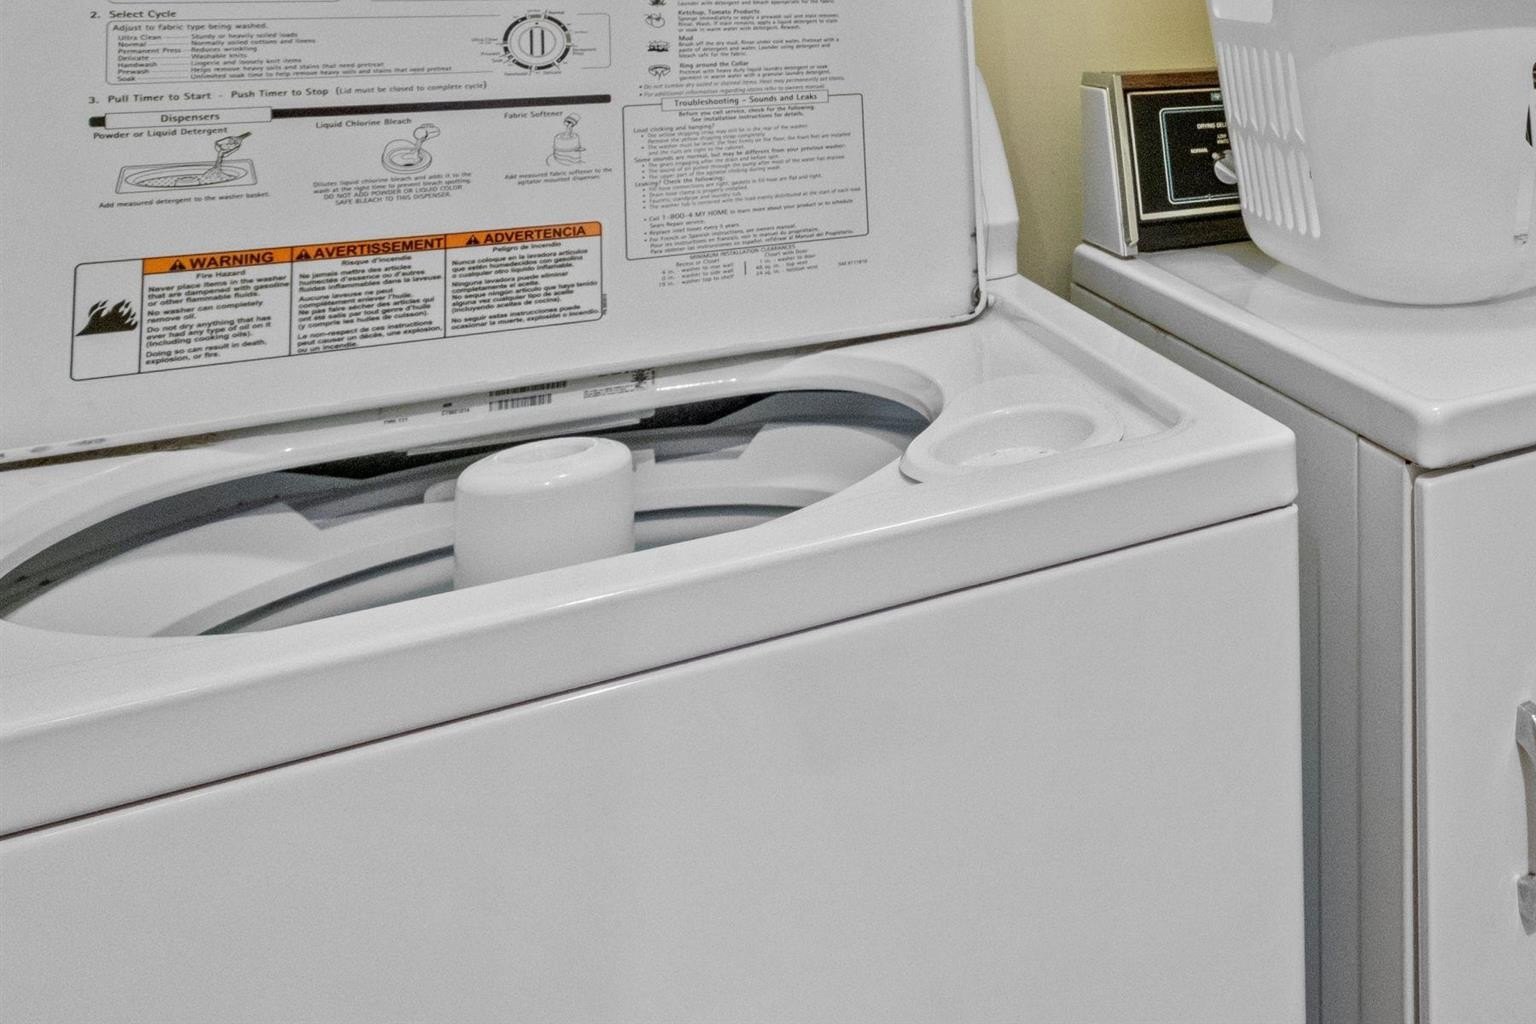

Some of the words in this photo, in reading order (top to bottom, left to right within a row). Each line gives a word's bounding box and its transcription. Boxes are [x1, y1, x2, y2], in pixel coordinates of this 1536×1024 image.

[89, 10, 101, 19] 2.
[108, 10, 144, 19] Select
[147, 9, 177, 20] Cycle
[112, 23, 142, 33] Adjust
[145, 24, 154, 32] to
[157, 23, 183, 31] fabric
[186, 23, 205, 33] type
[207, 23, 232, 32] being
[235, 22, 267, 30] washed.
[117, 61, 158, 69] Handwash
[87, 96, 99, 105] 3.
[107, 93, 129, 103] Pull
[133, 93, 165, 102] Timer
[168, 93, 180, 101] to
[183, 91, 212, 101] Start
[231, 90, 256, 99] Push
[259, 89, 289, 98] Timer
[305, 87, 329, 97] Stop
[335, 86, 352, 96] (Lid
[354, 86, 374, 94] must
[377, 85, 387, 93] be
[389, 85, 414, 93] closed
[426, 83, 462, 93] complete
[674, 97, 740, 108] Troubleshooting
[749, 94, 778, 104] Sounds
[779, 94, 794, 102] and
[796, 92, 818, 101] Leaks
[160, 113, 221, 124] Dispensers
[503, 111, 528, 120] Fabric
[530, 110, 564, 118] Softener
[315, 121, 343, 130] Liquid
[345, 119, 381, 128] Chlorine
[384, 117, 412, 126] Bleach
[93, 130, 131, 140] Powder
[146, 128, 178, 138] Liquid
[180, 127, 228, 136] Detergent
[483, 225, 587, 244] ADVERTENCIA
[313, 237, 444, 259] AVERTISSEMENT
[189, 251, 274, 269] WARNING
[215, 269, 246, 278] Hazard
[148, 285, 174, 293] Never
[177, 283, 201, 291] place
[203, 280, 228, 288] items
[256, 275, 287, 283] washer
[184, 287, 231, 297] dampened
[253, 281, 290, 291] gasoline
